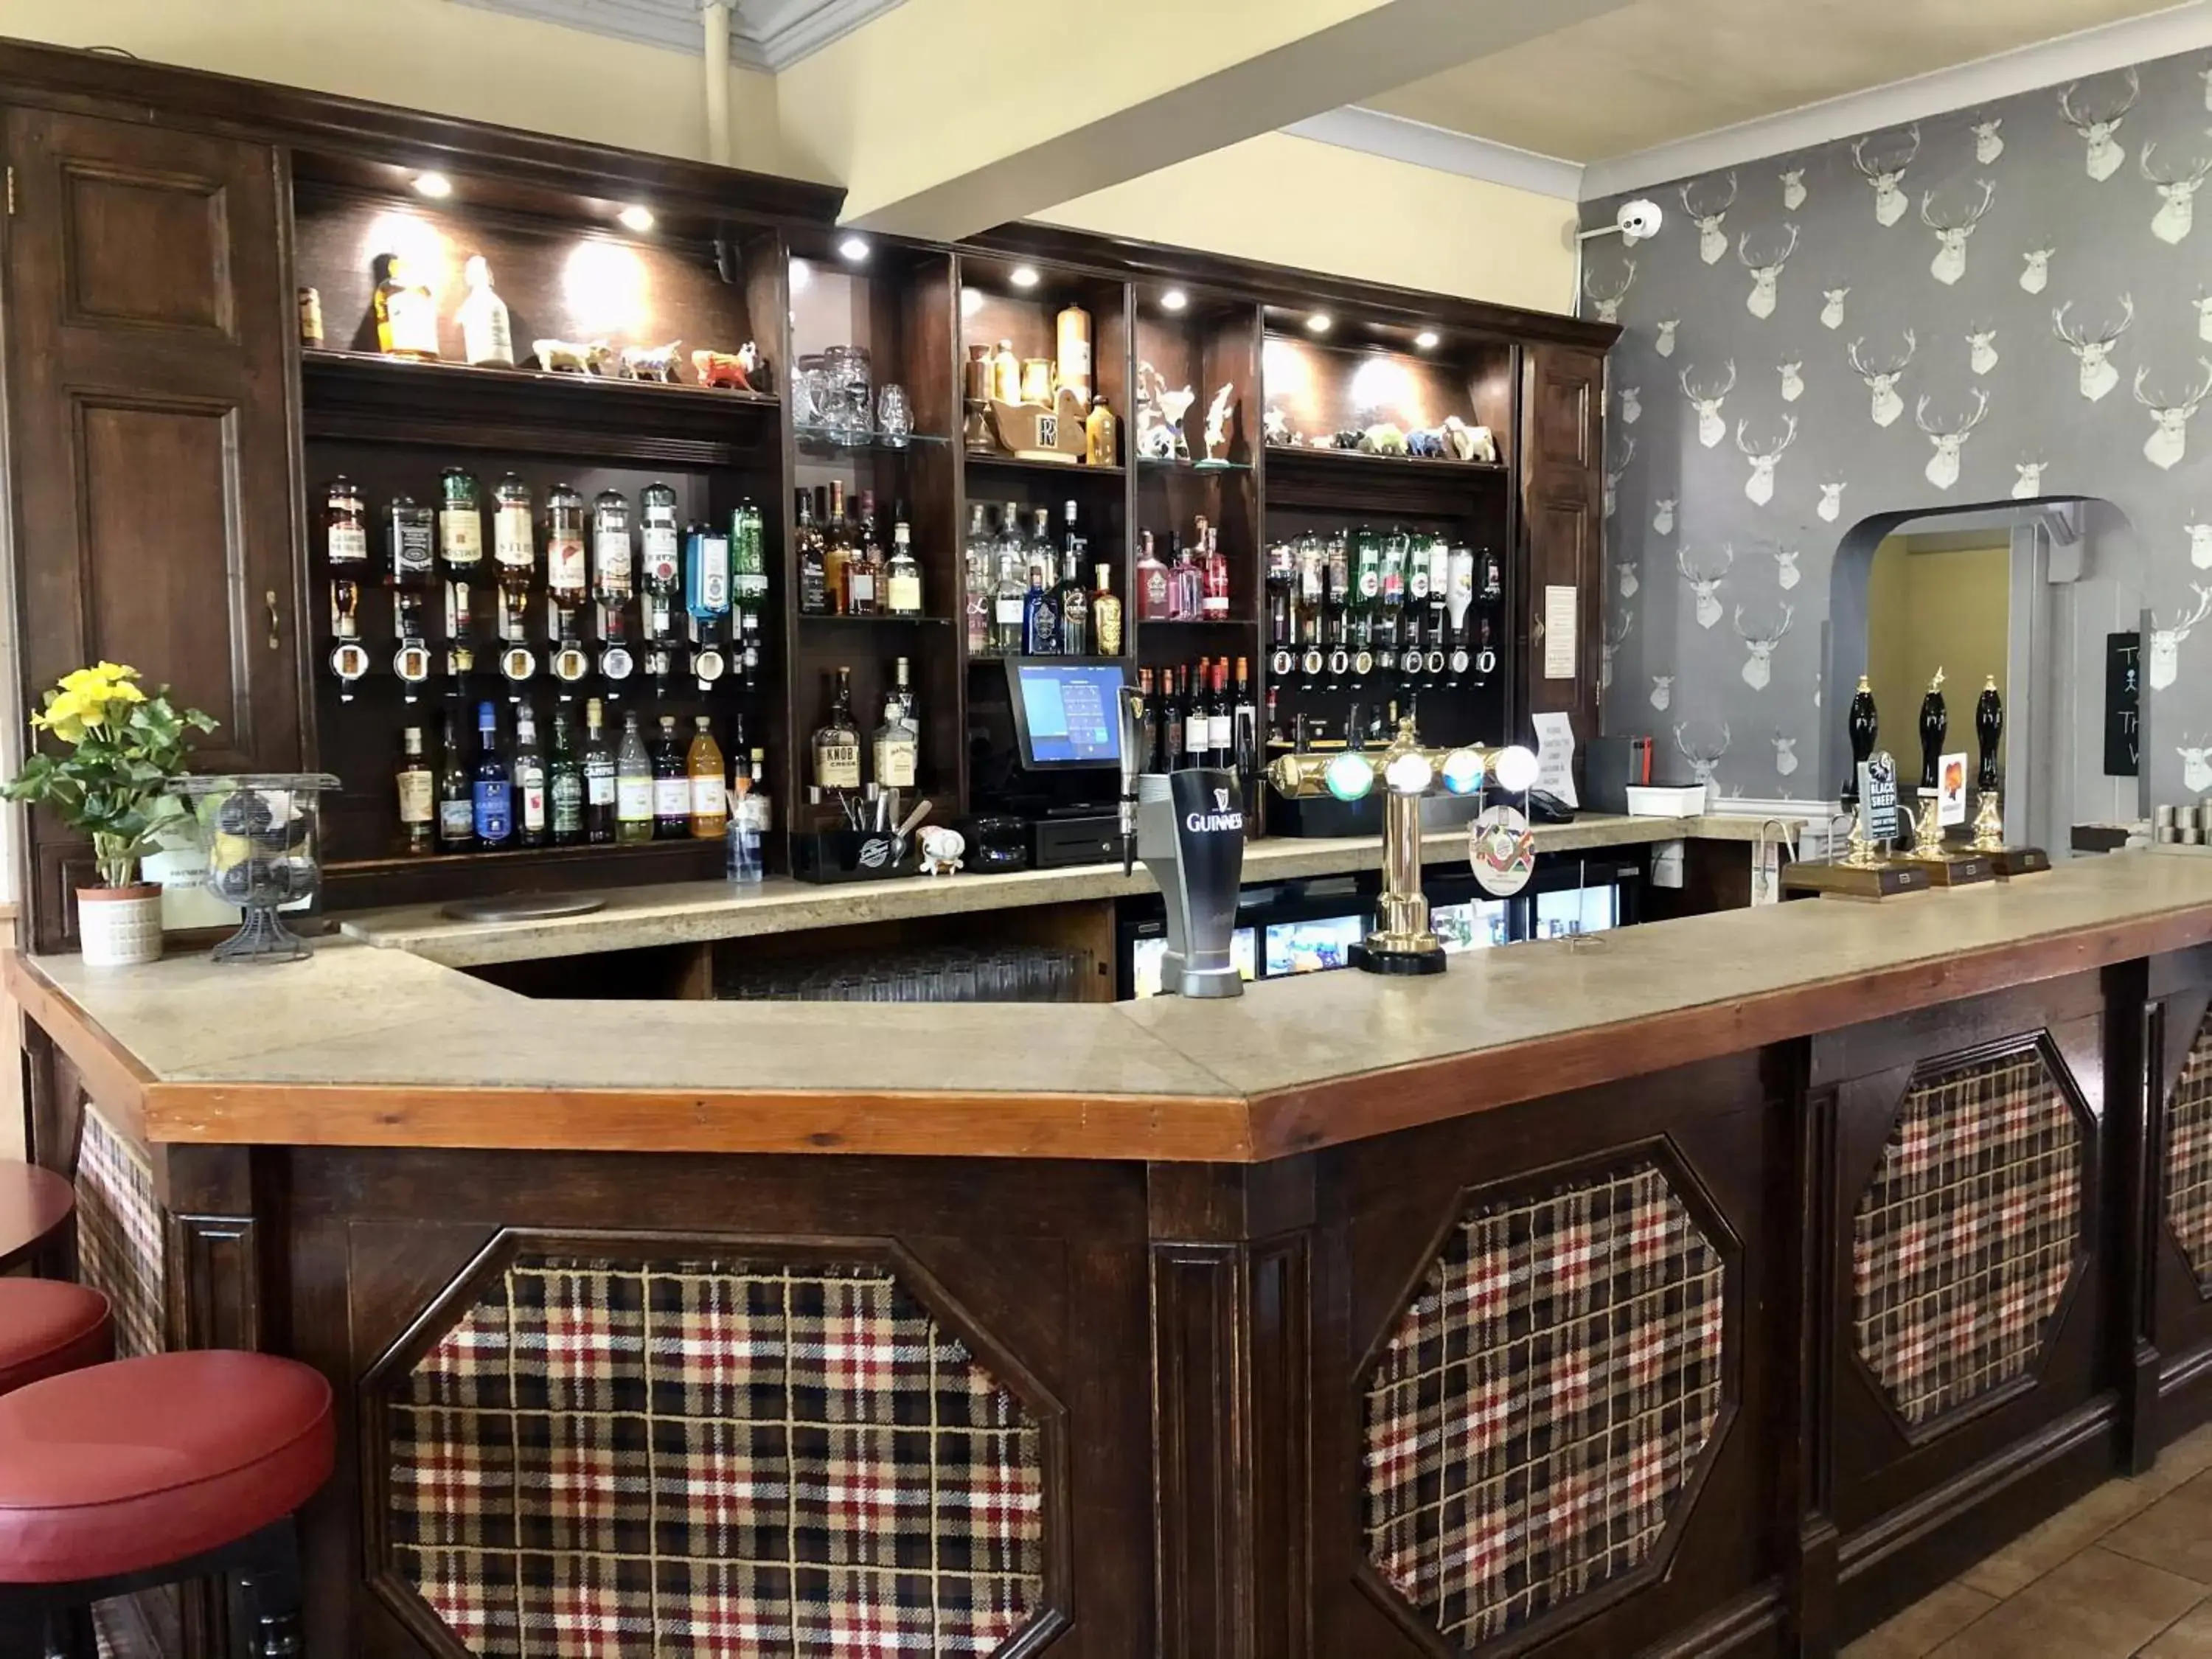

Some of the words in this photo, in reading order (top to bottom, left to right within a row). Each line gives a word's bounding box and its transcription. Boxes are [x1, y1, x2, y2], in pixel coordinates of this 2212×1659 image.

[827, 747, 853, 761] KNOB
[1871, 782, 1894, 794] BLACK
[1871, 794, 1895, 807] SHEEP
[1186, 812, 1243, 832] GUINNESS
